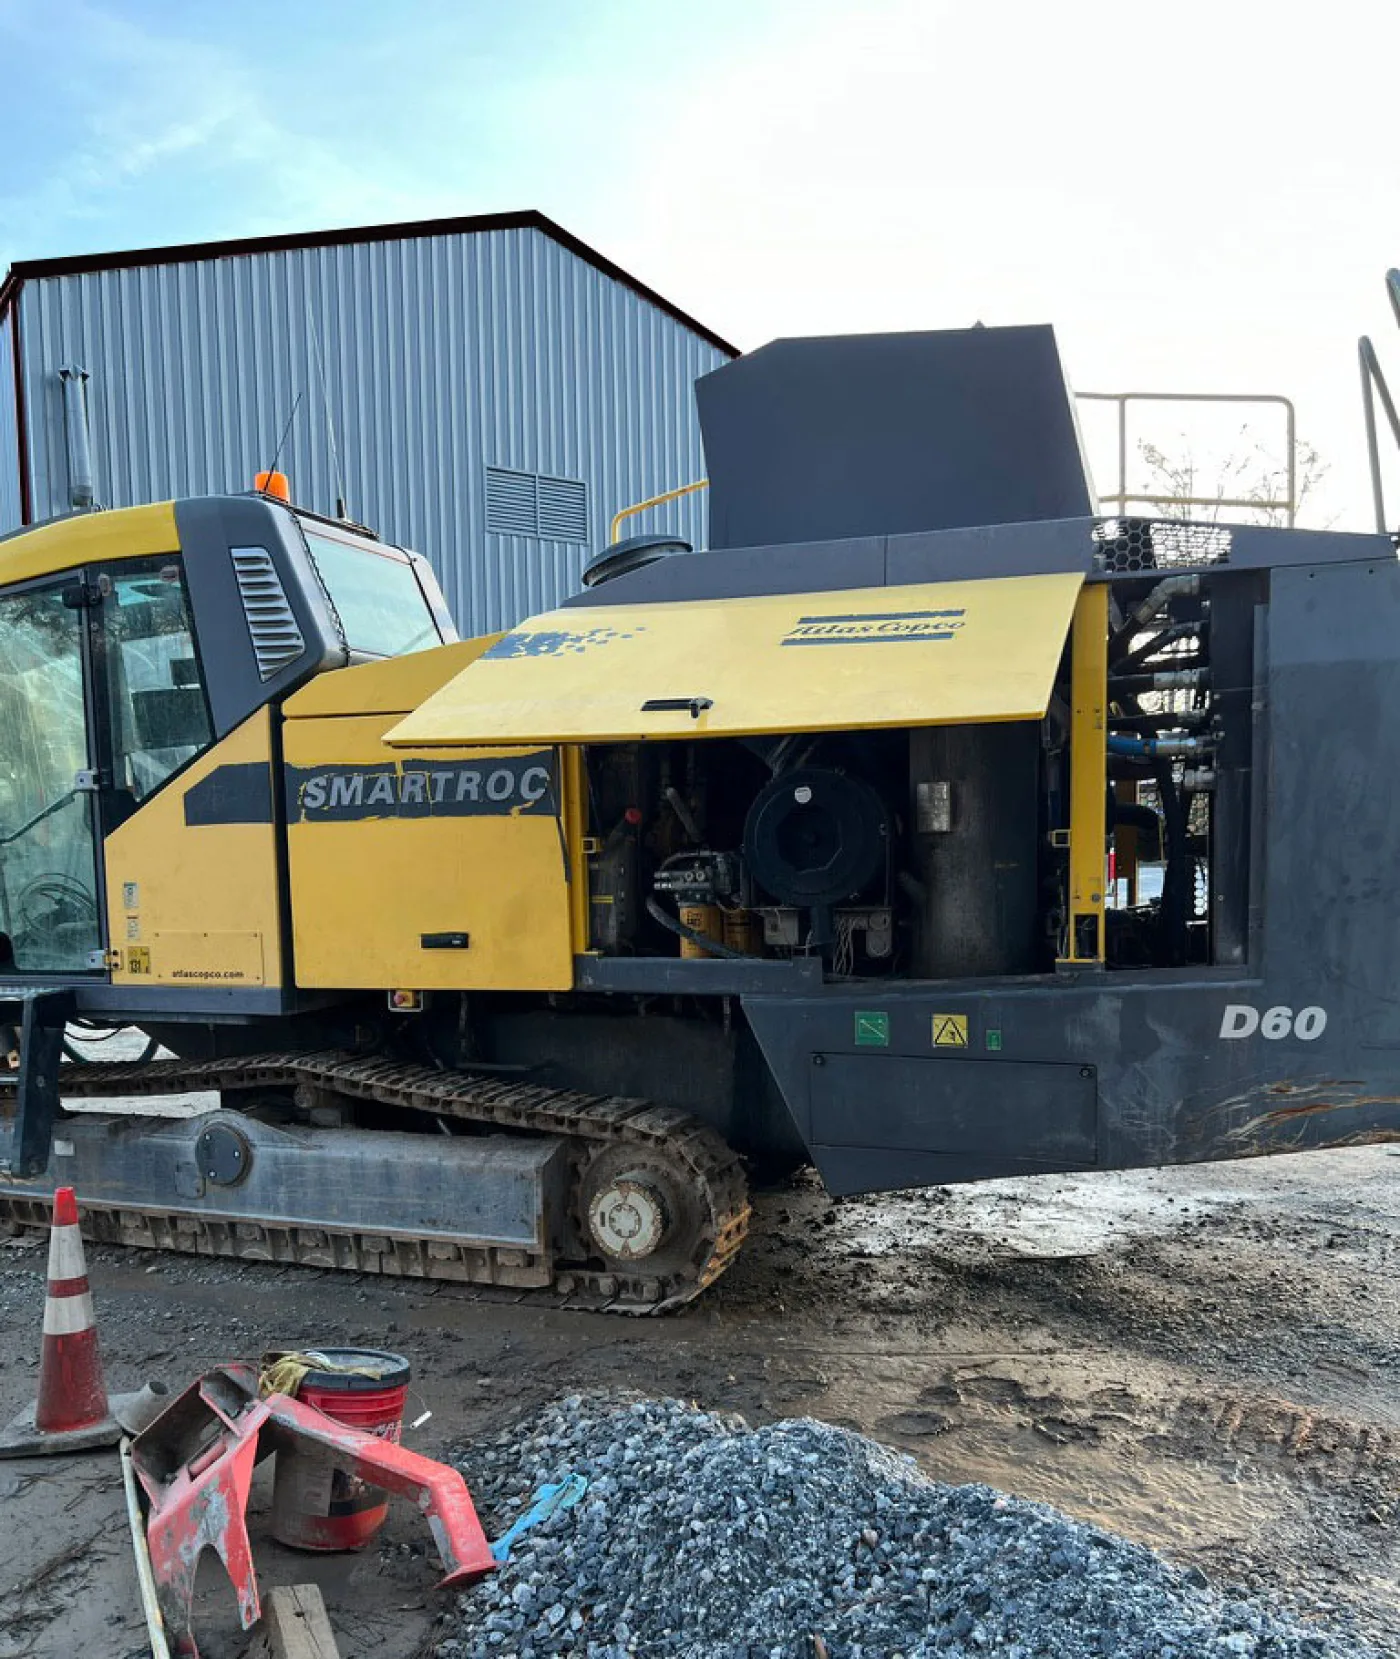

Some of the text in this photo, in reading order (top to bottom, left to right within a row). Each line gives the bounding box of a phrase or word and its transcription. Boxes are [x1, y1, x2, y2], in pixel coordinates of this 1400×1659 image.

[876, 620, 966, 635] Copco
[303, 766, 550, 809] SMARTROC
[172, 969, 244, 979] atlascopco.com
[1218, 1004, 1328, 1041] D60
